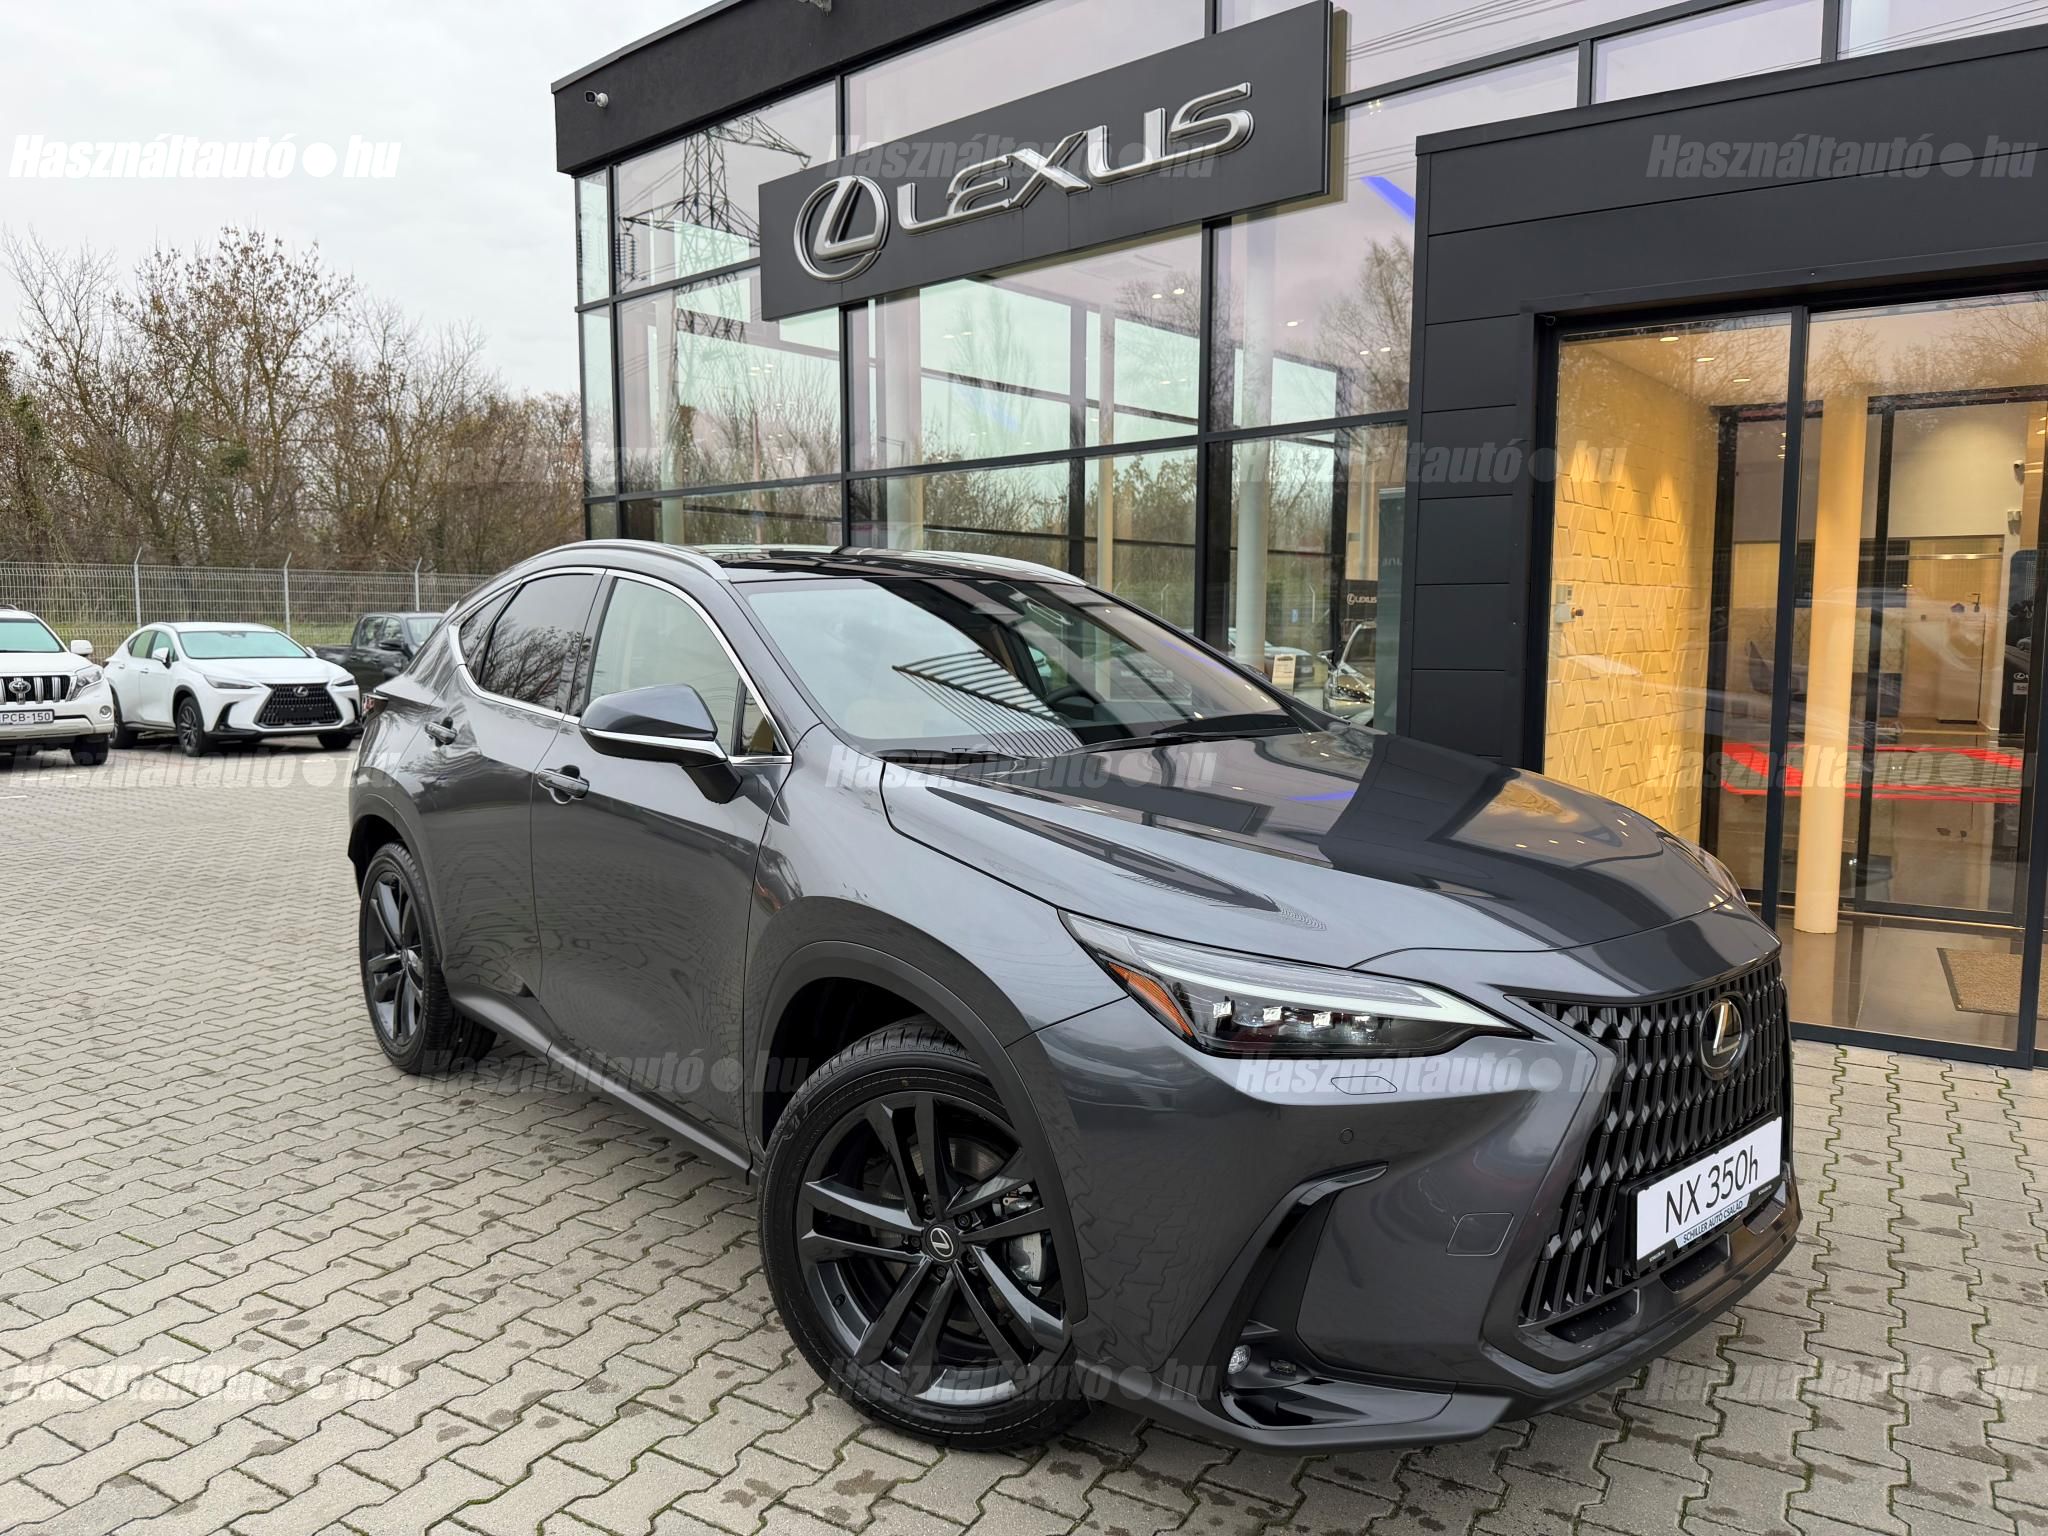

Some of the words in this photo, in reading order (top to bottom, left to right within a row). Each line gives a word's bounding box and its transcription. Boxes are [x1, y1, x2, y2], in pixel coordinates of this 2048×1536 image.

[896, 81, 1255, 235] LEXUS
[2, 712, 51, 722] PCB-150
[1665, 1174, 1702, 1233] NX
[1706, 1145, 1758, 1209] 350h
[1683, 1222, 1708, 1243] SCHILLER
